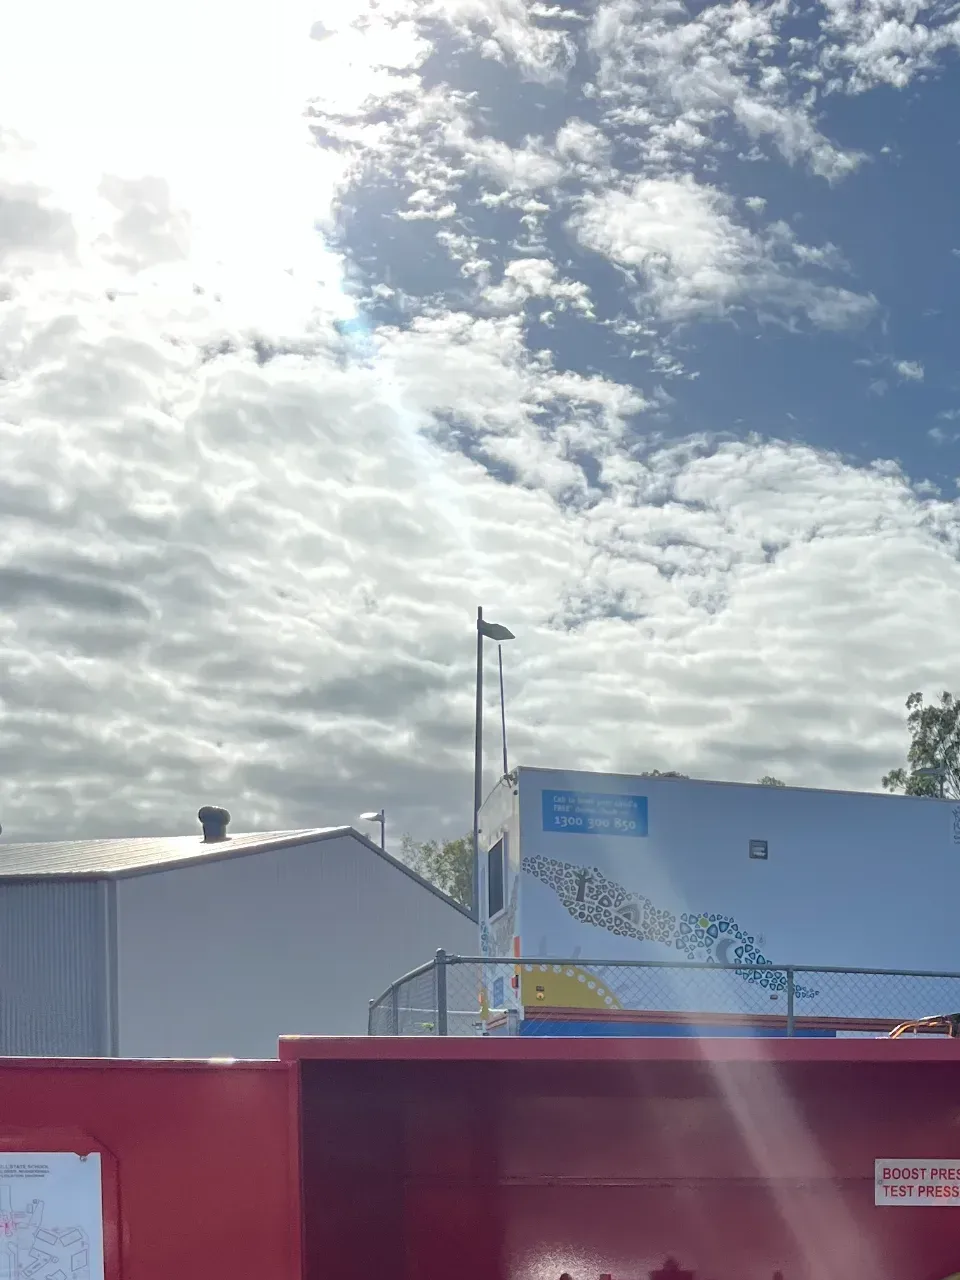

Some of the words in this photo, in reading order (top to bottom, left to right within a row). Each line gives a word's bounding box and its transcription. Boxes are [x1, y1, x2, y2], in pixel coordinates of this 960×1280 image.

[554, 815, 583, 828] 1300
[587, 817, 610, 830] 300
[614, 817, 637, 832] 850
[883, 1167, 927, 1180] BOOST
[883, 1185, 914, 1197] TEST
